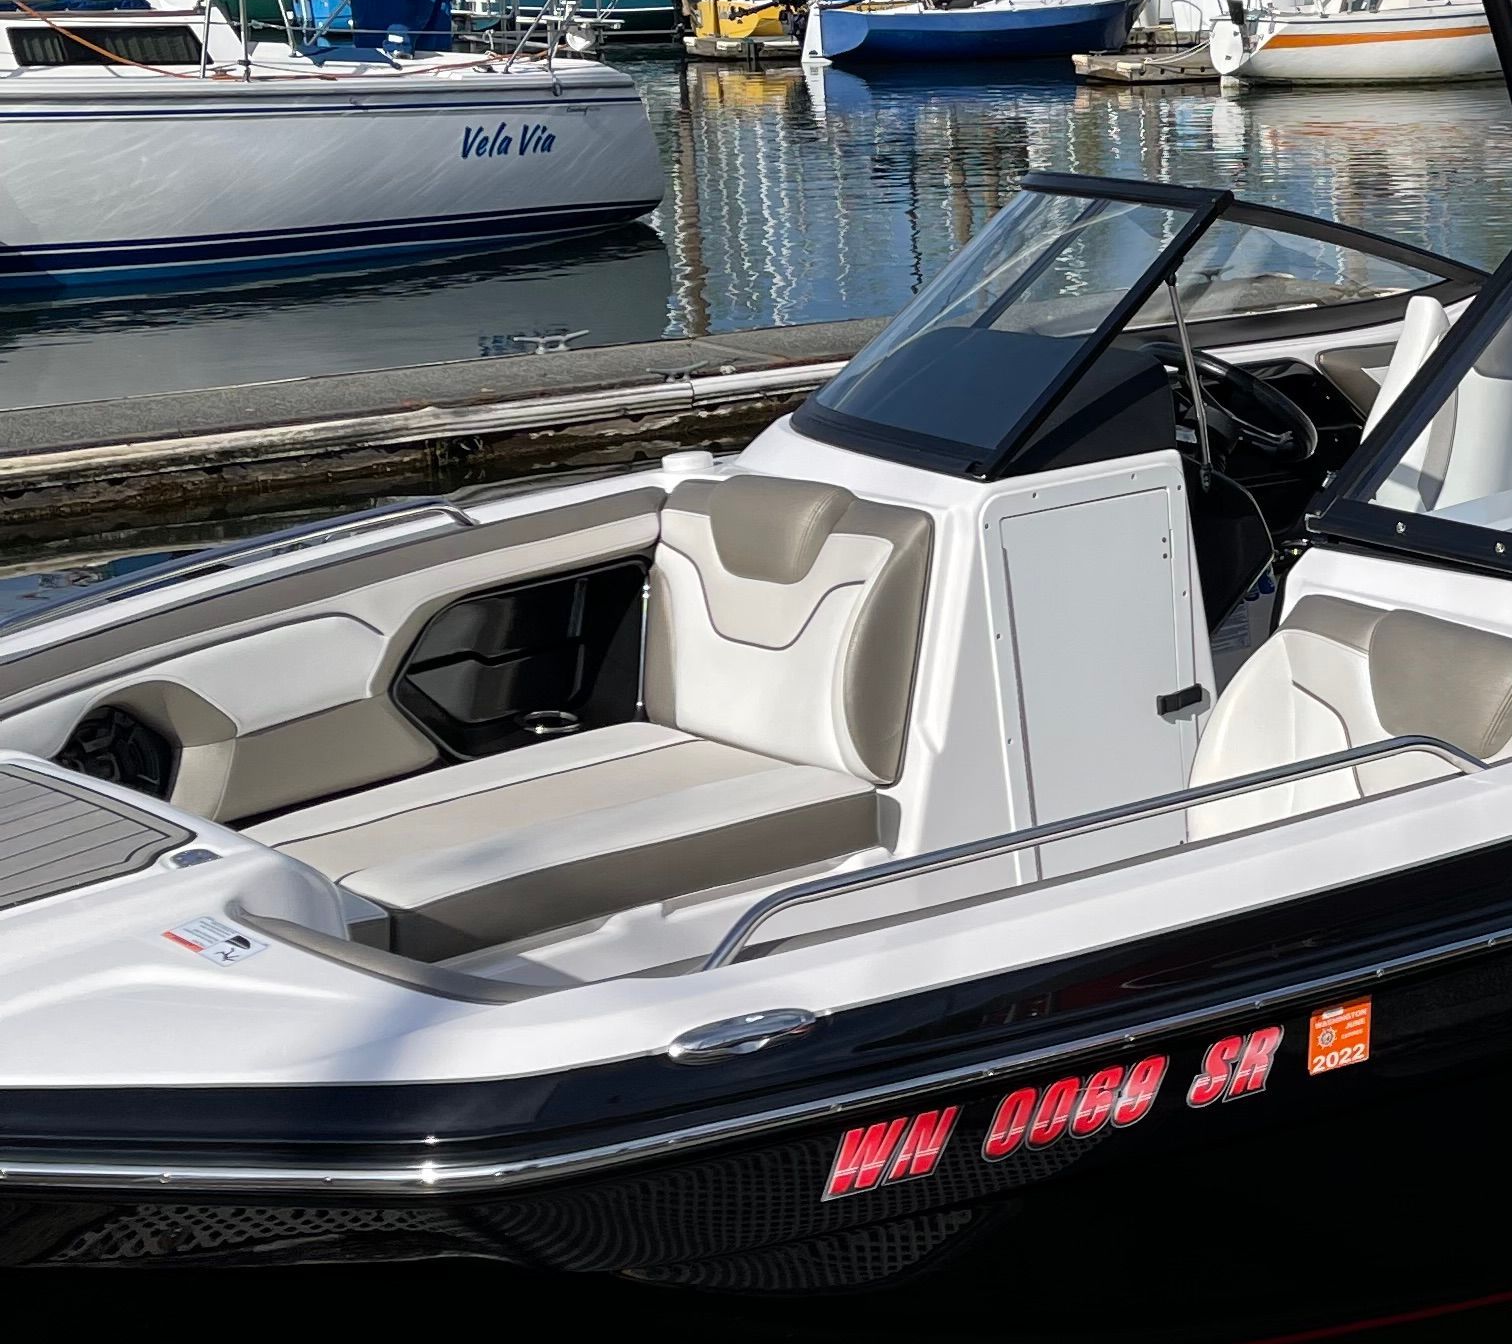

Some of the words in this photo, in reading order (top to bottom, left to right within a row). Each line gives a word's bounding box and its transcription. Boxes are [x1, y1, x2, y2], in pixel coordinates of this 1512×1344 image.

[461, 122, 512, 159] Vela
[519, 124, 556, 155] Via
[1312, 1043, 1365, 1073] 2022
[820, 1105, 961, 1202] WN
[981, 1054, 1169, 1162] 0069
[1186, 1024, 1284, 1108] SR
